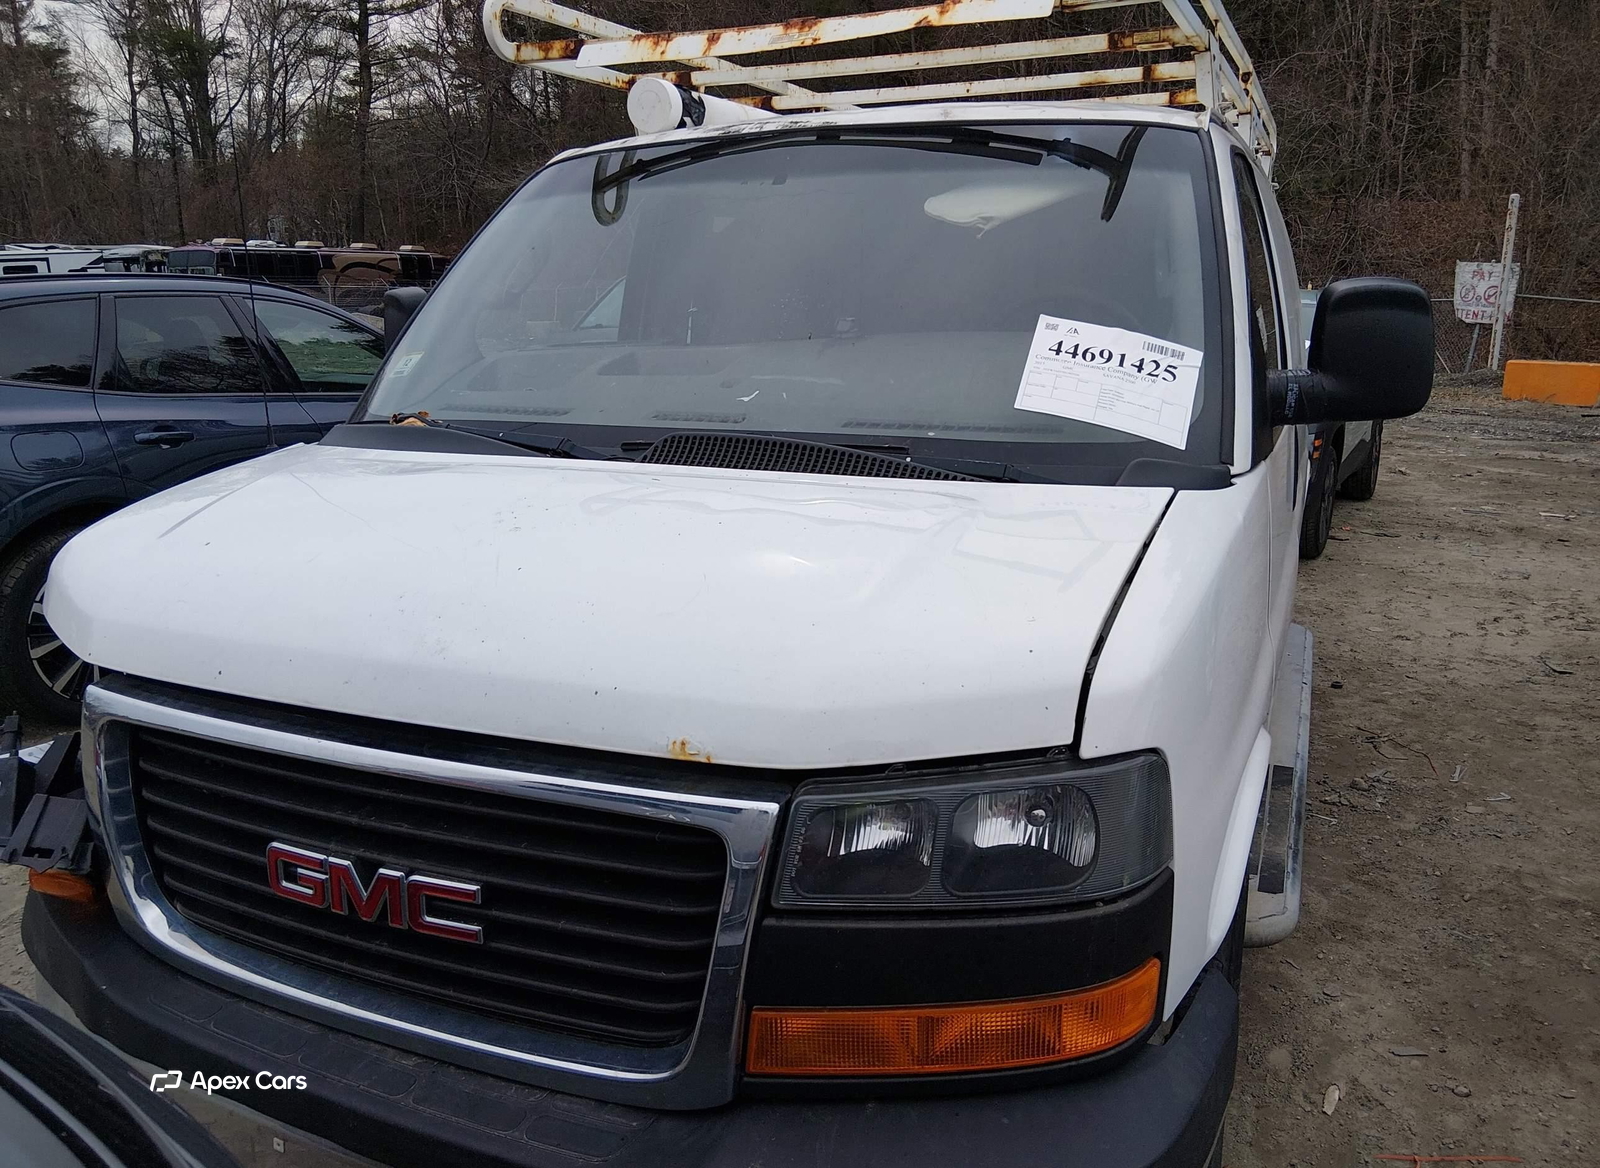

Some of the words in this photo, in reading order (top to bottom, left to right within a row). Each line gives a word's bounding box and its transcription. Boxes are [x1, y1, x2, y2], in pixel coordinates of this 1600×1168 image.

[1048, 339, 1179, 383] 44691425
[1073, 360, 1107, 371] Insurance
[1107, 366, 1139, 381] Company
[266, 841, 484, 945] GMC
